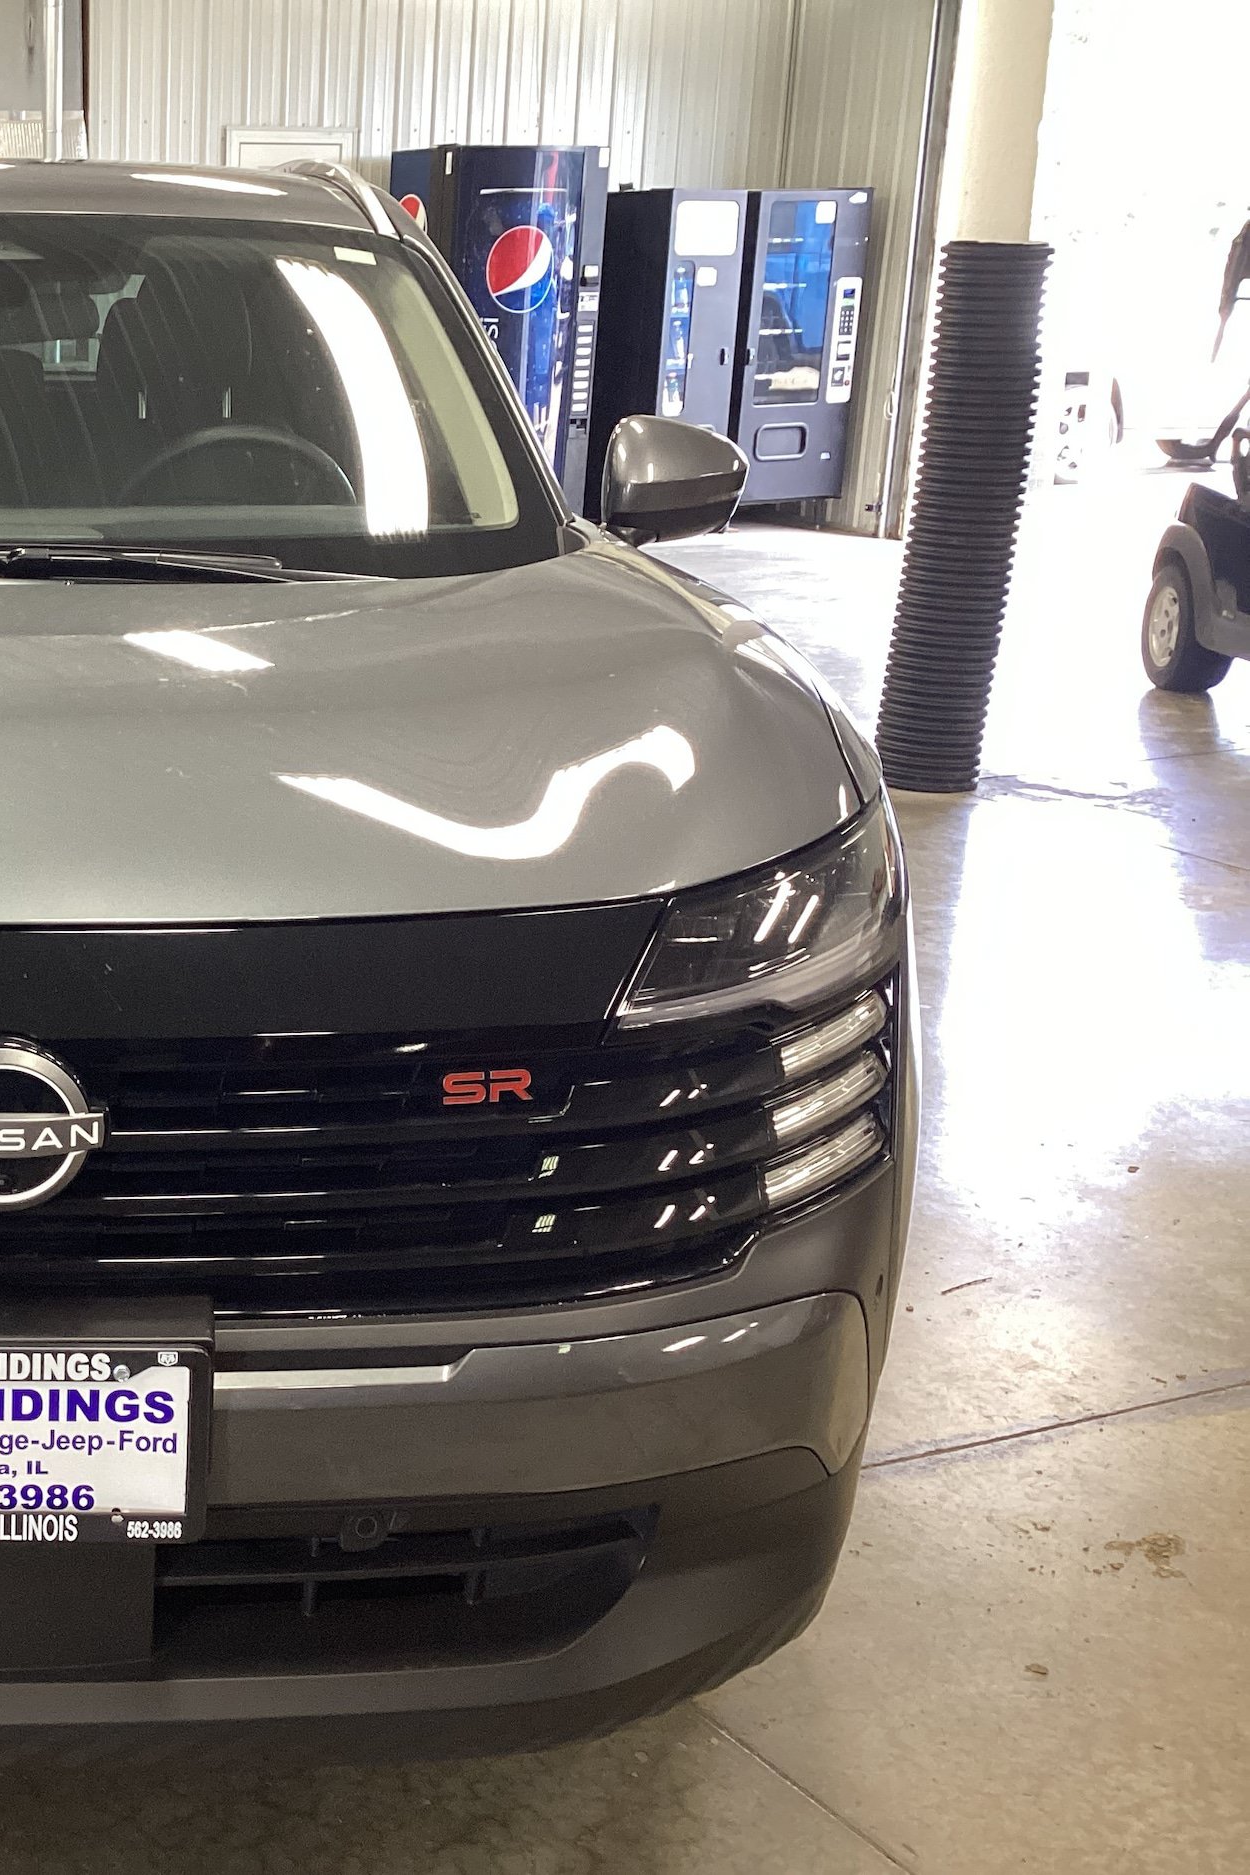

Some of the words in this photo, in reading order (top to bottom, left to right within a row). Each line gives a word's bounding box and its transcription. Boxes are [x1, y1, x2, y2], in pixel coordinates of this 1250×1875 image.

[442, 1068, 534, 1106] SR
[26, 1461, 49, 1475] IL
[126, 1520, 182, 1539] 562-3986
